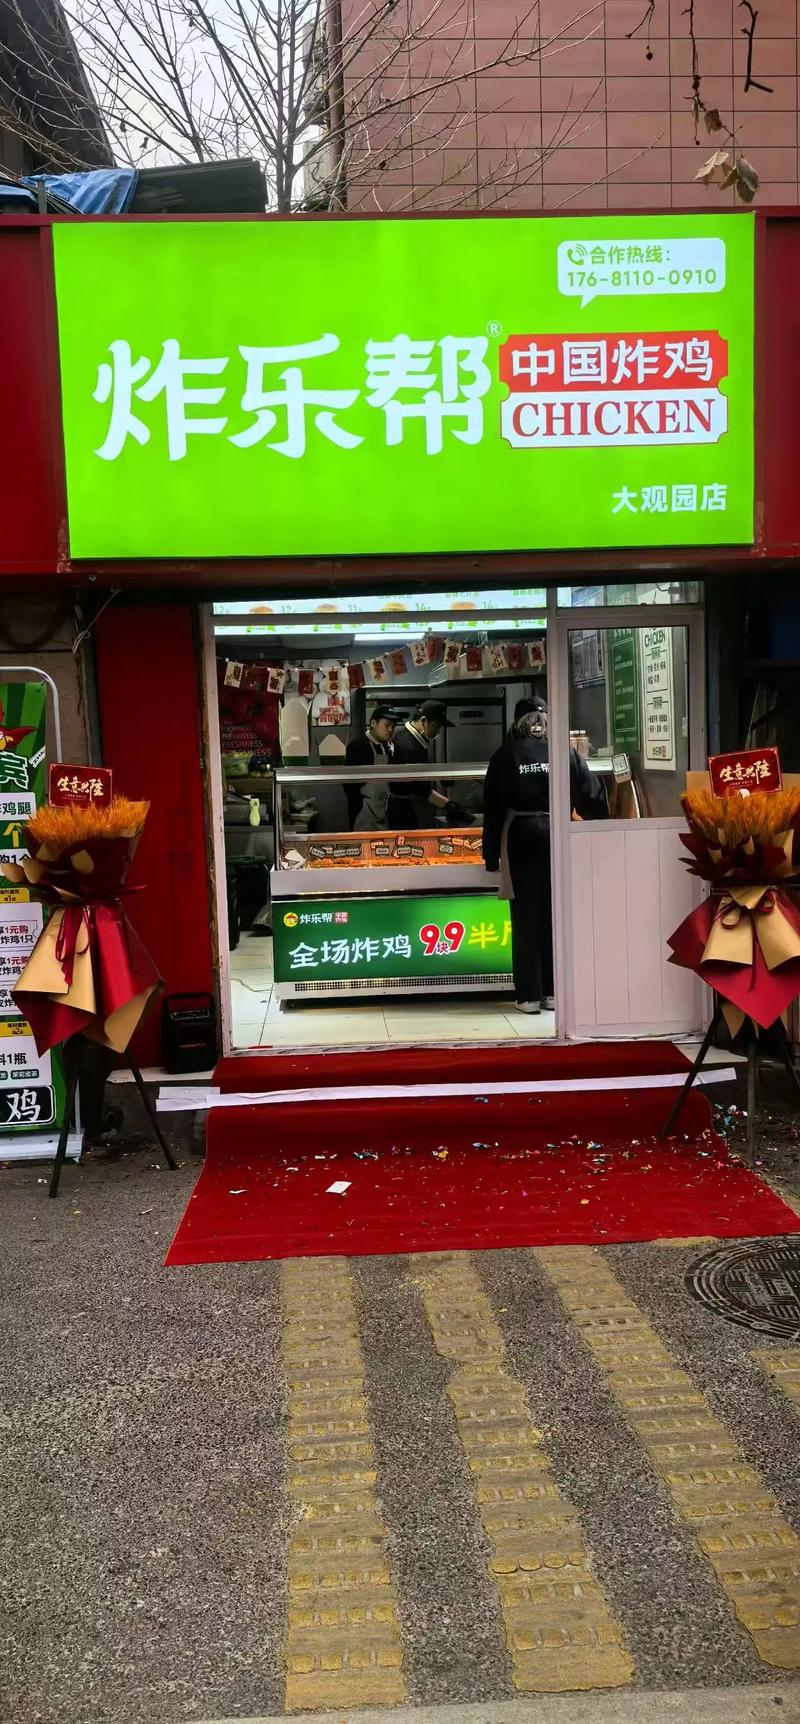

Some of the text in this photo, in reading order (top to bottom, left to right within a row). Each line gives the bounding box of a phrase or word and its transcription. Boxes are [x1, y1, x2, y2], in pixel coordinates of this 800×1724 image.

[567, 268, 718, 288] 176-8110-0910
[511, 337, 715, 387] 中国炸鸡
[92, 332, 491, 461] 炸乐帮
[511, 398, 715, 438] CHICKEN
[610, 484, 729, 514] 大观园店
[644, 630, 666, 647] CHICKEN
[0, 802, 31, 815] 鸡腿
[300, 913, 333, 925] 炸乐帮
[289, 933, 412, 970] 全场炸鸡
[7, 1089, 41, 1122] 鸡
